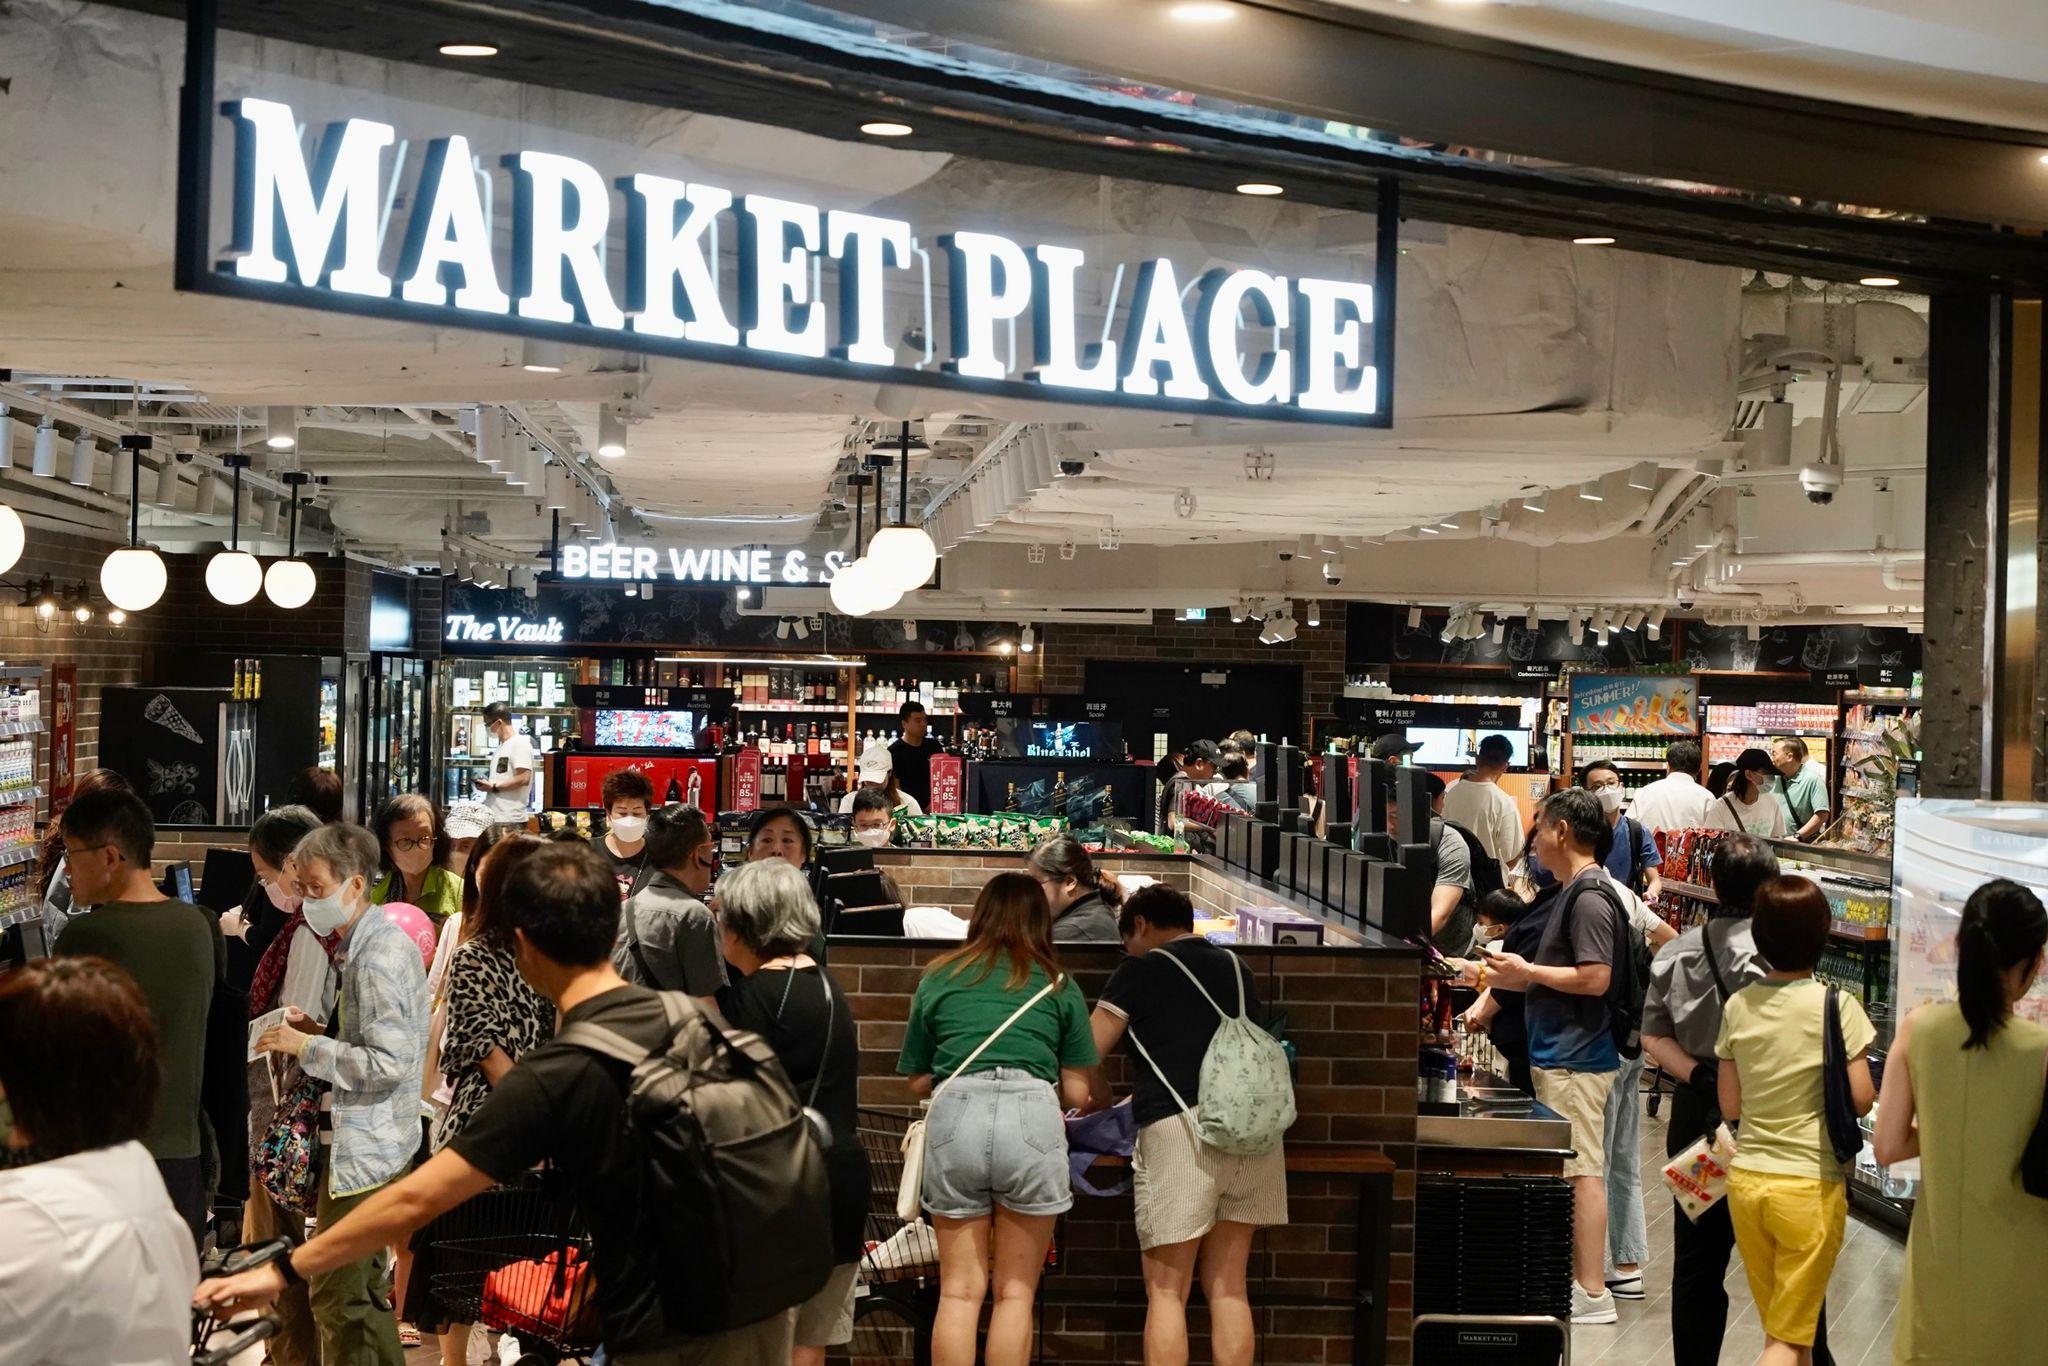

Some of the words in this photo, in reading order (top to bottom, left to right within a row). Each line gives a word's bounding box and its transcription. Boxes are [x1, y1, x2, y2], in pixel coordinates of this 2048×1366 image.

[234, 97, 913, 367] MARKET
[950, 230, 1379, 415] PLACE
[562, 544, 658, 580] BEER
[668, 548, 772, 583] WINE
[781, 549, 809, 583] &
[446, 614, 494, 641] The
[497, 616, 565, 643] Vault
[991, 700, 1013, 709] 意大利
[1085, 702, 1108, 711] 西班牙
[994, 709, 1008, 717] Italy
[1397, 718, 1414, 726] Spain
[1478, 718, 1503, 727] Sparkling
